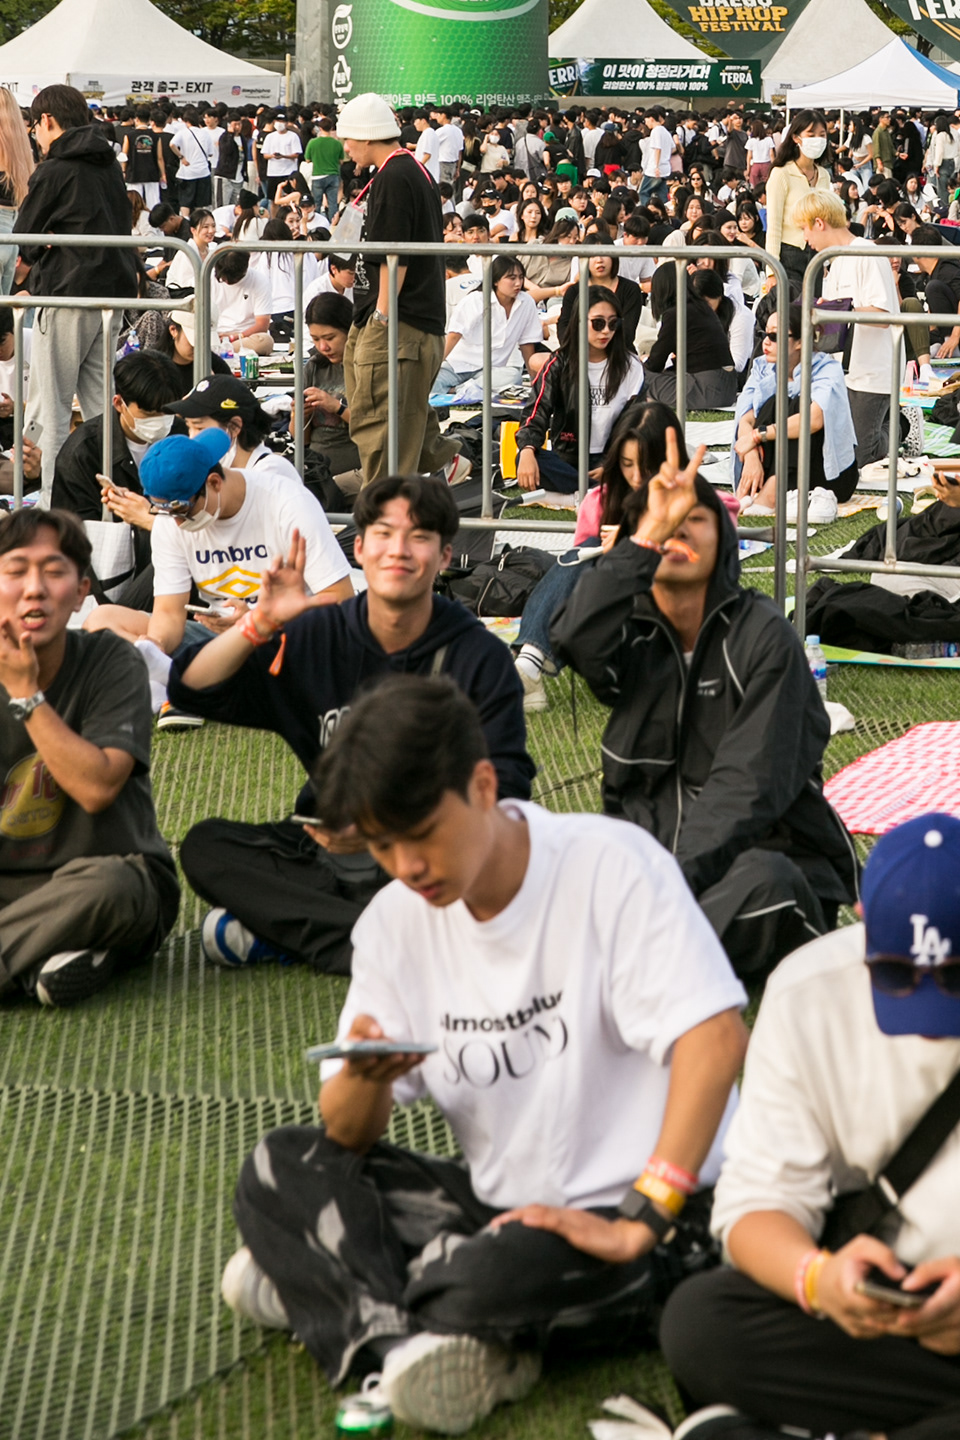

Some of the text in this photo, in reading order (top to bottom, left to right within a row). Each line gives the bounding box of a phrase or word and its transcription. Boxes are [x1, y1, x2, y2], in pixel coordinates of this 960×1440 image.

[687, 6, 789, 22] HIPHOP
[699, 21, 786, 32] FESTIVAL
[603, 64, 615, 79] 이
[619, 64, 644, 79] 맛이
[719, 71, 754, 85] TERRA
[131, 80, 154, 93] 관객
[635, 81, 655, 91] 100%
[688, 81, 709, 91] 100%
[414, 93, 438, 106] 만든
[440, 93, 473, 106] 100%
[475, 93, 517, 106] 리얼탄산
[195, 544, 268, 564] umbro
[909, 913, 952, 967] LA
